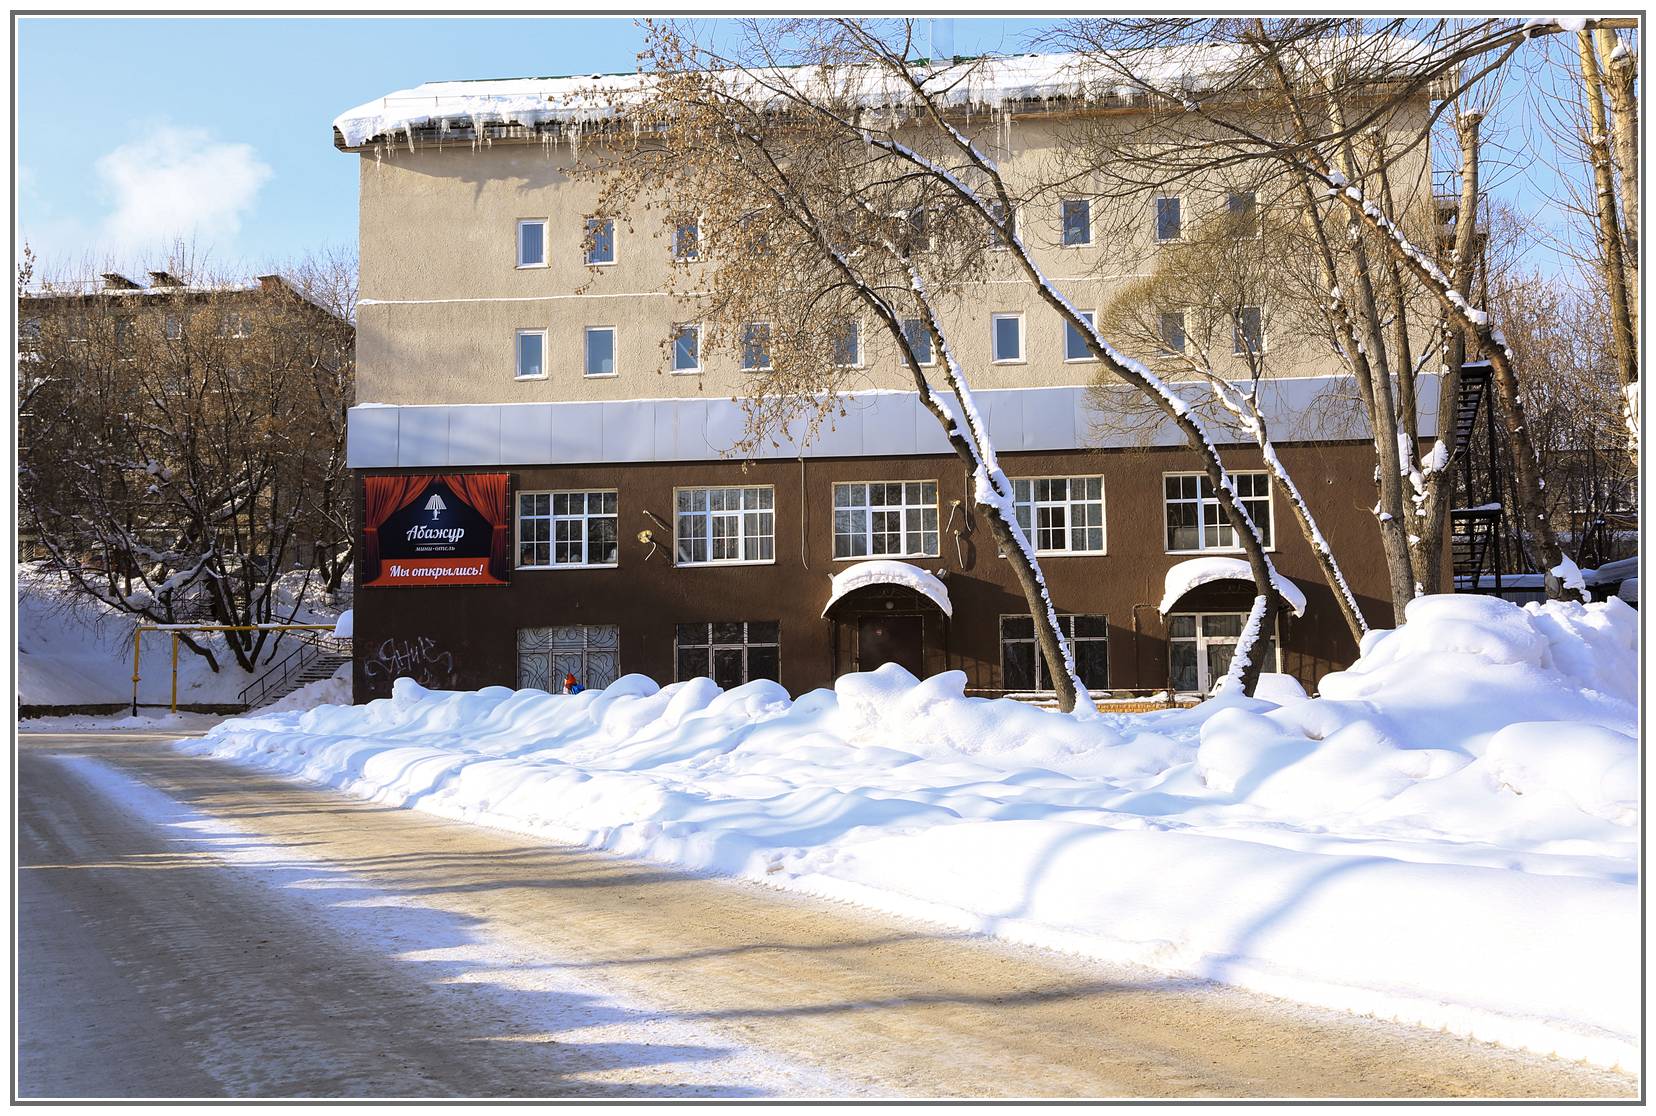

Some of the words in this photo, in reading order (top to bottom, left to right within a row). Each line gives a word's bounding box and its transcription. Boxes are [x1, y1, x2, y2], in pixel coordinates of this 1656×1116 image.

[406, 524, 465, 543] Абажур
[389, 565, 410, 577] Мы
[411, 564, 484, 579] открылись!
